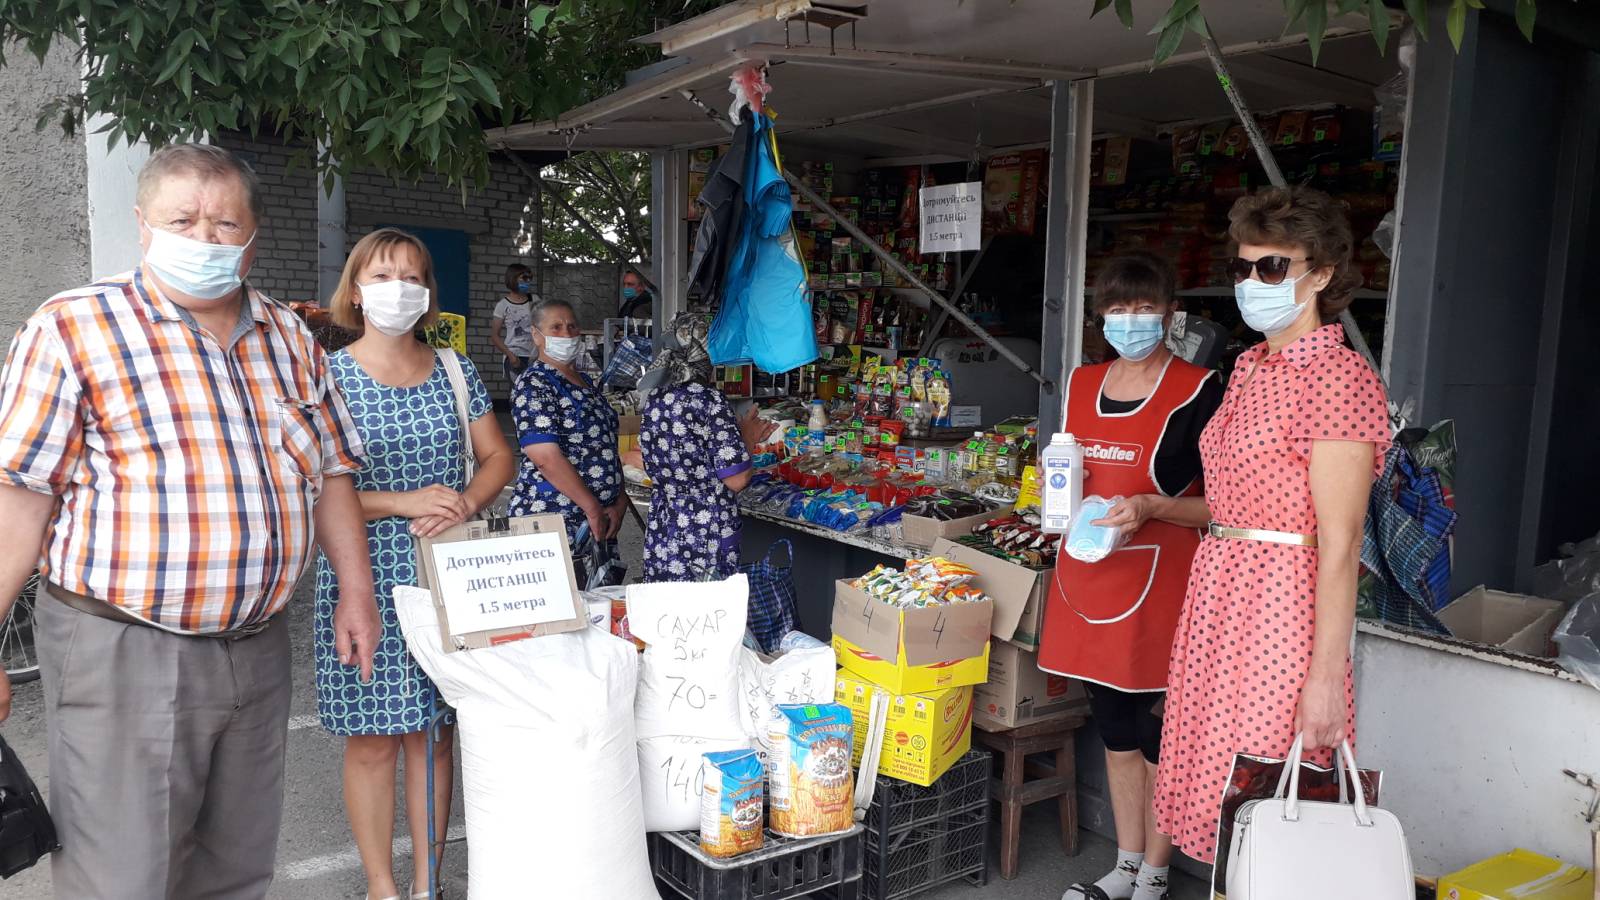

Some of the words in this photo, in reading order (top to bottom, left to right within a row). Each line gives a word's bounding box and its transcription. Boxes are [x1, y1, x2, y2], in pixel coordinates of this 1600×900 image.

[1080, 444, 1135, 461] cCoffee
[446, 548, 556, 571] Дотримуйтесь
[479, 601, 500, 614] 1.5
[503, 597, 547, 611] метра
[863, 599, 874, 633] 4
[933, 610, 946, 649] 4
